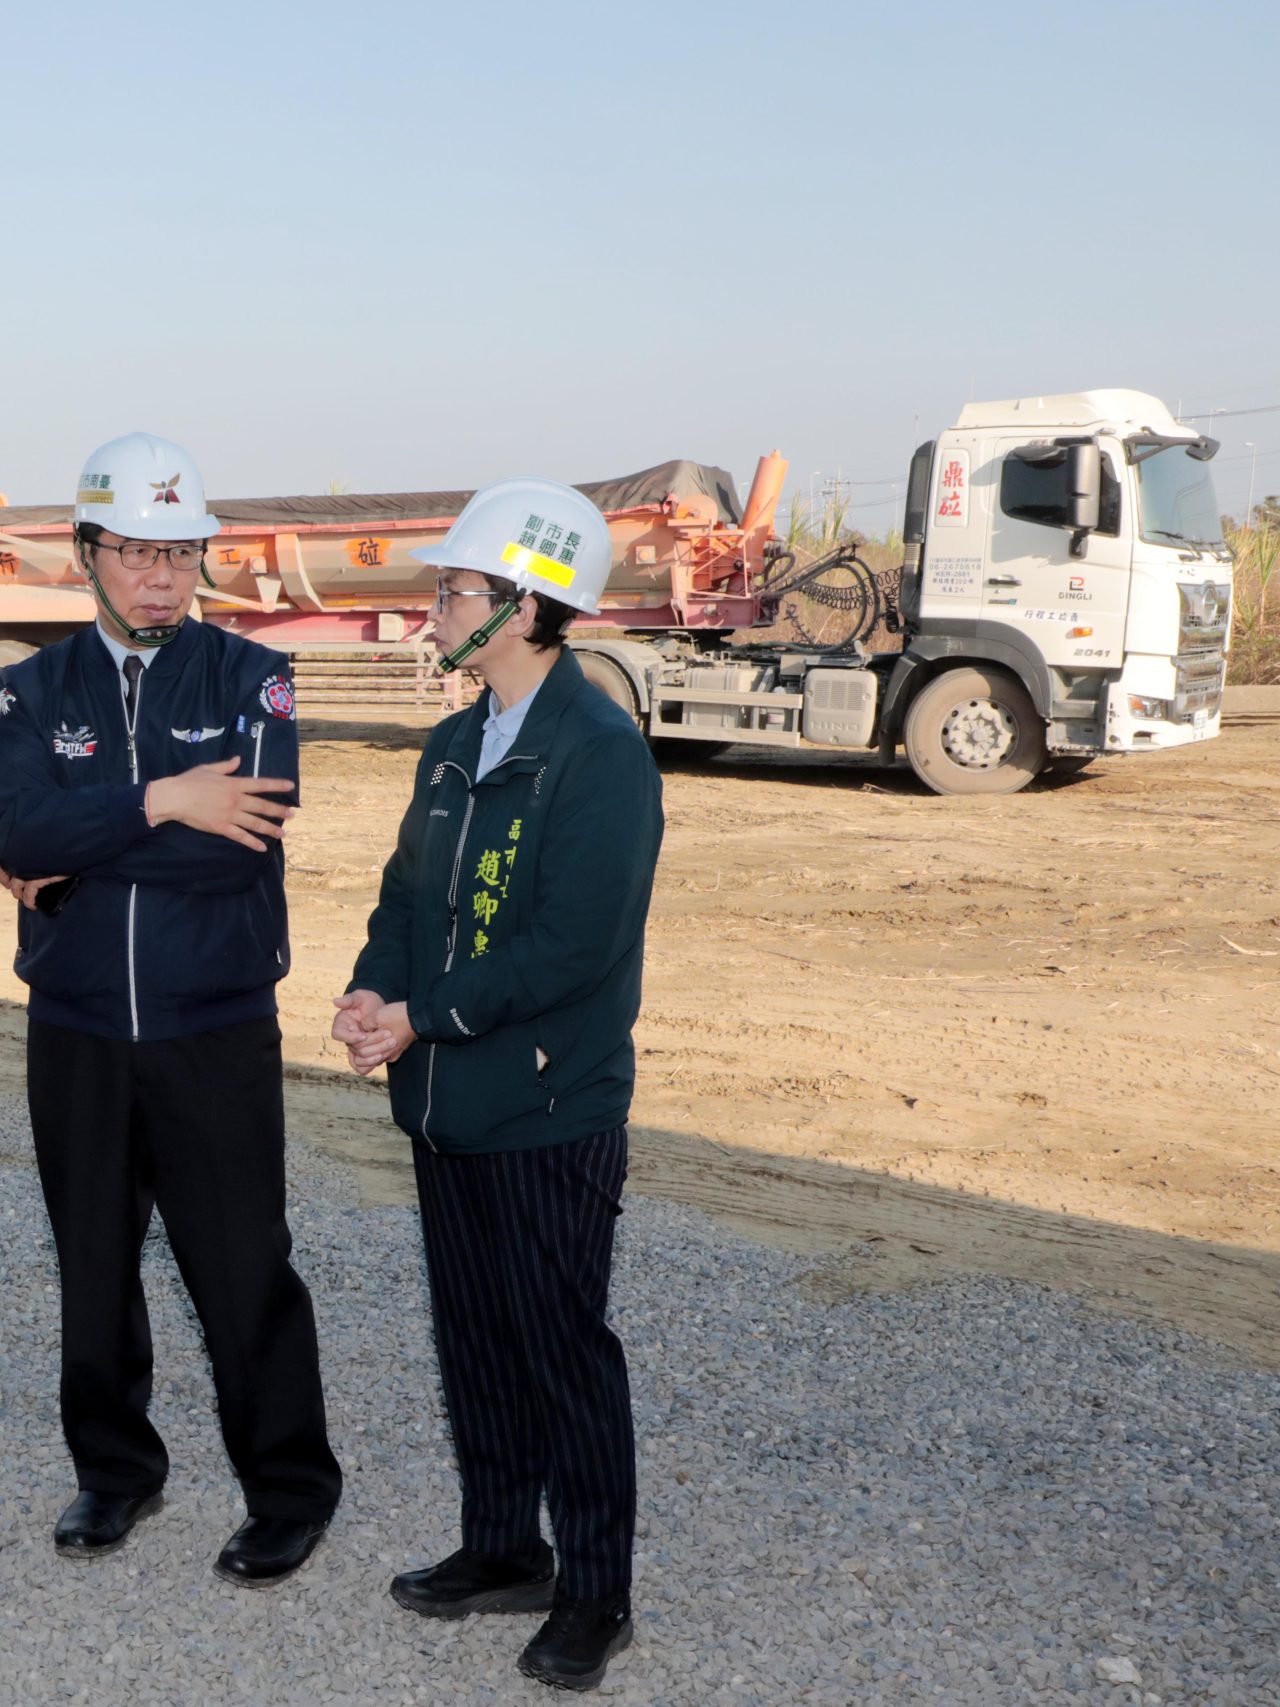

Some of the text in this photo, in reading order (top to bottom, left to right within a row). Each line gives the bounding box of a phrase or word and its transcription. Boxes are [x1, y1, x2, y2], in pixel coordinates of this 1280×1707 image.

[525, 514, 581, 550] 副市長
[518, 530, 576, 566] 趙卿惠
[1058, 591, 1093, 601] DINGLI
[1073, 648, 1112, 658] 2041
